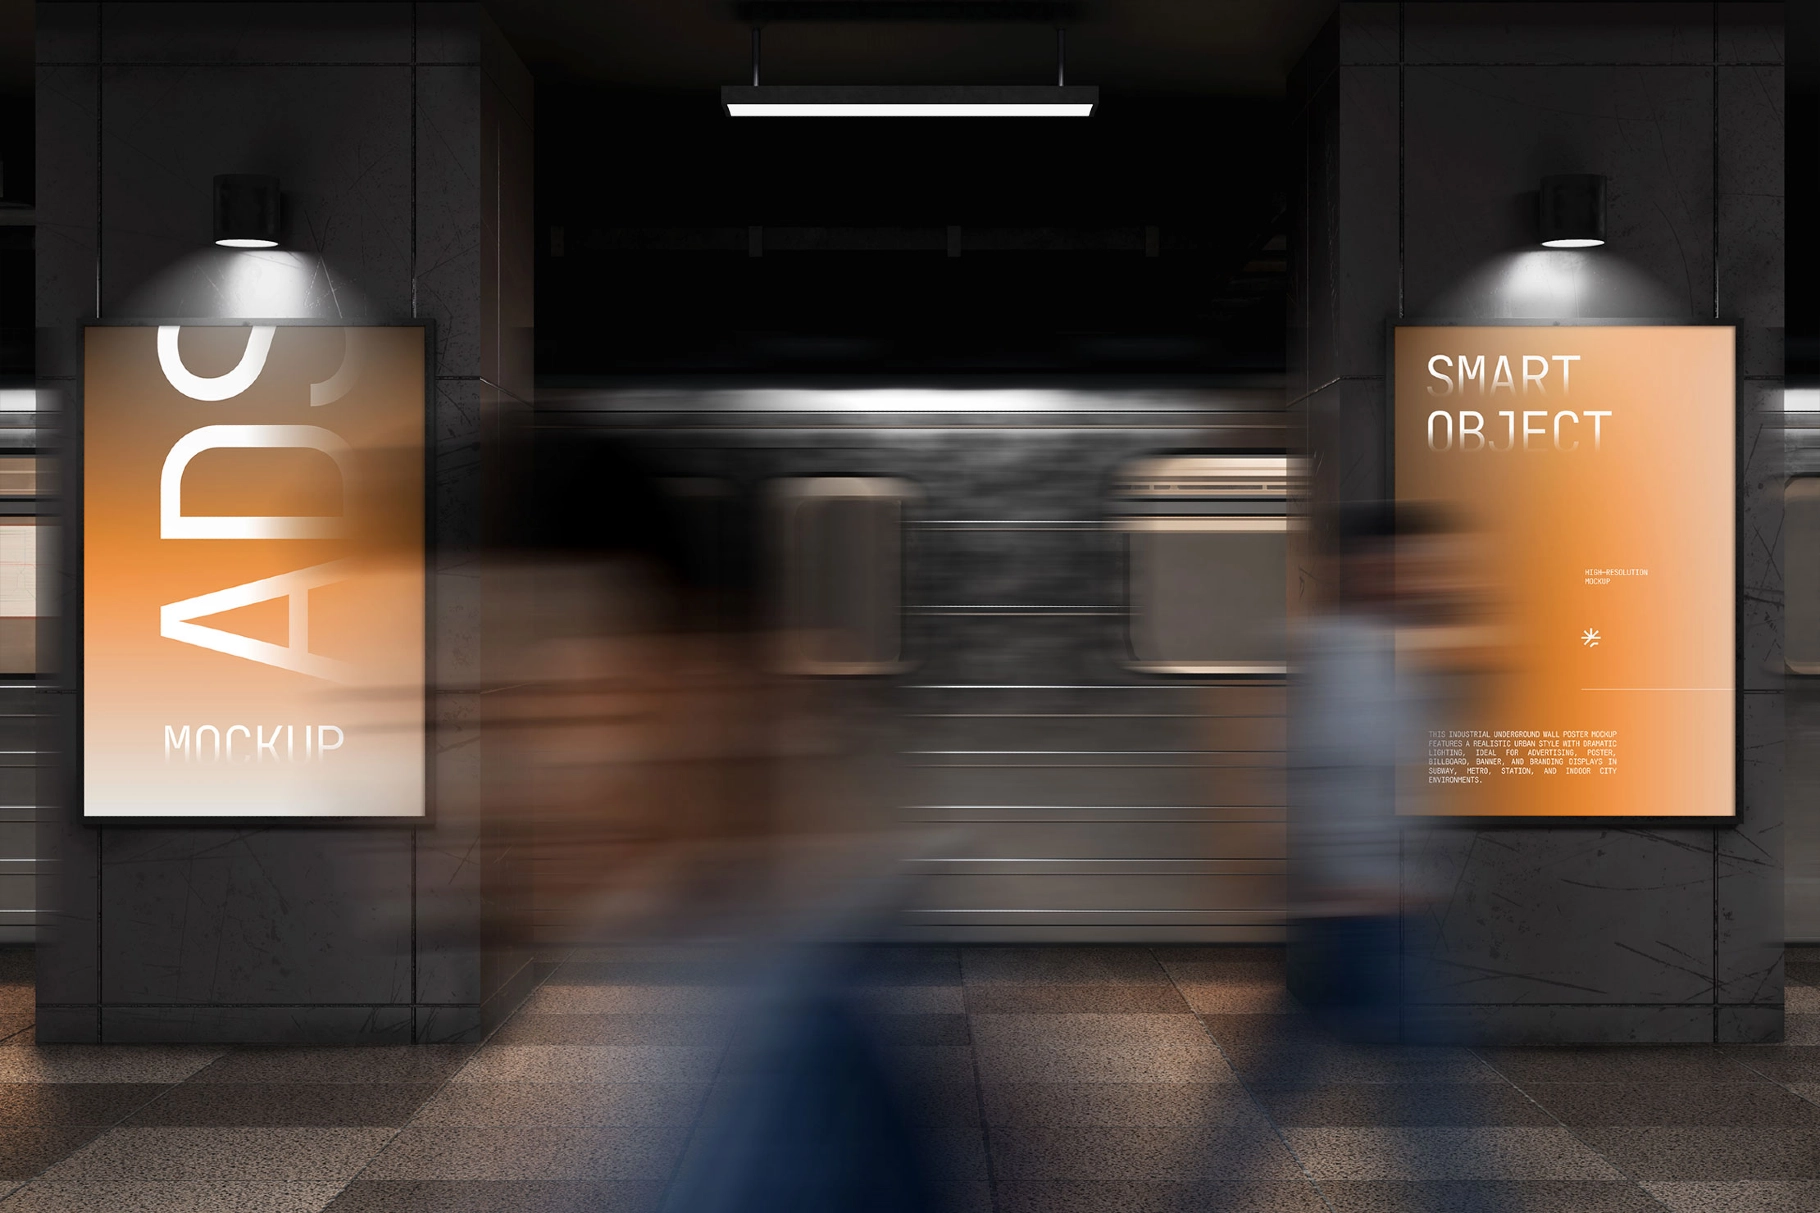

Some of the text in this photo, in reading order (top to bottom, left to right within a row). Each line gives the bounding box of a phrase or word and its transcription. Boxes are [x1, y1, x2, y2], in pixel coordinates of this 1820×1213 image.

[1427, 354, 1581, 398] SMART
[1427, 410, 1612, 453] OBJECT
[157, 326, 358, 684] ADS
[1584, 568, 1648, 576] HIGH-RESOLUTION
[1584, 577, 1611, 585] MOCKUP
[1428, 730, 1617, 738] THIS INDUSTRIAL UNDERGROUND WALL POSTER MOCKUP
[164, 725, 344, 764] MOCKUP
[1428, 749, 1466, 757] LIGHTING,
[1527, 749, 1577, 757] ADVERTISING,
[1587, 749, 1616, 757] POSTER,
[1428, 758, 1470, 766] BILLBOARD,
[1476, 758, 1505, 766] BANNER,
[1428, 767, 1617, 776] SUBWAY, METRO, STATION, AND INDOOR CITY
[1428, 776, 1482, 784] ENVIRONMENTS.
